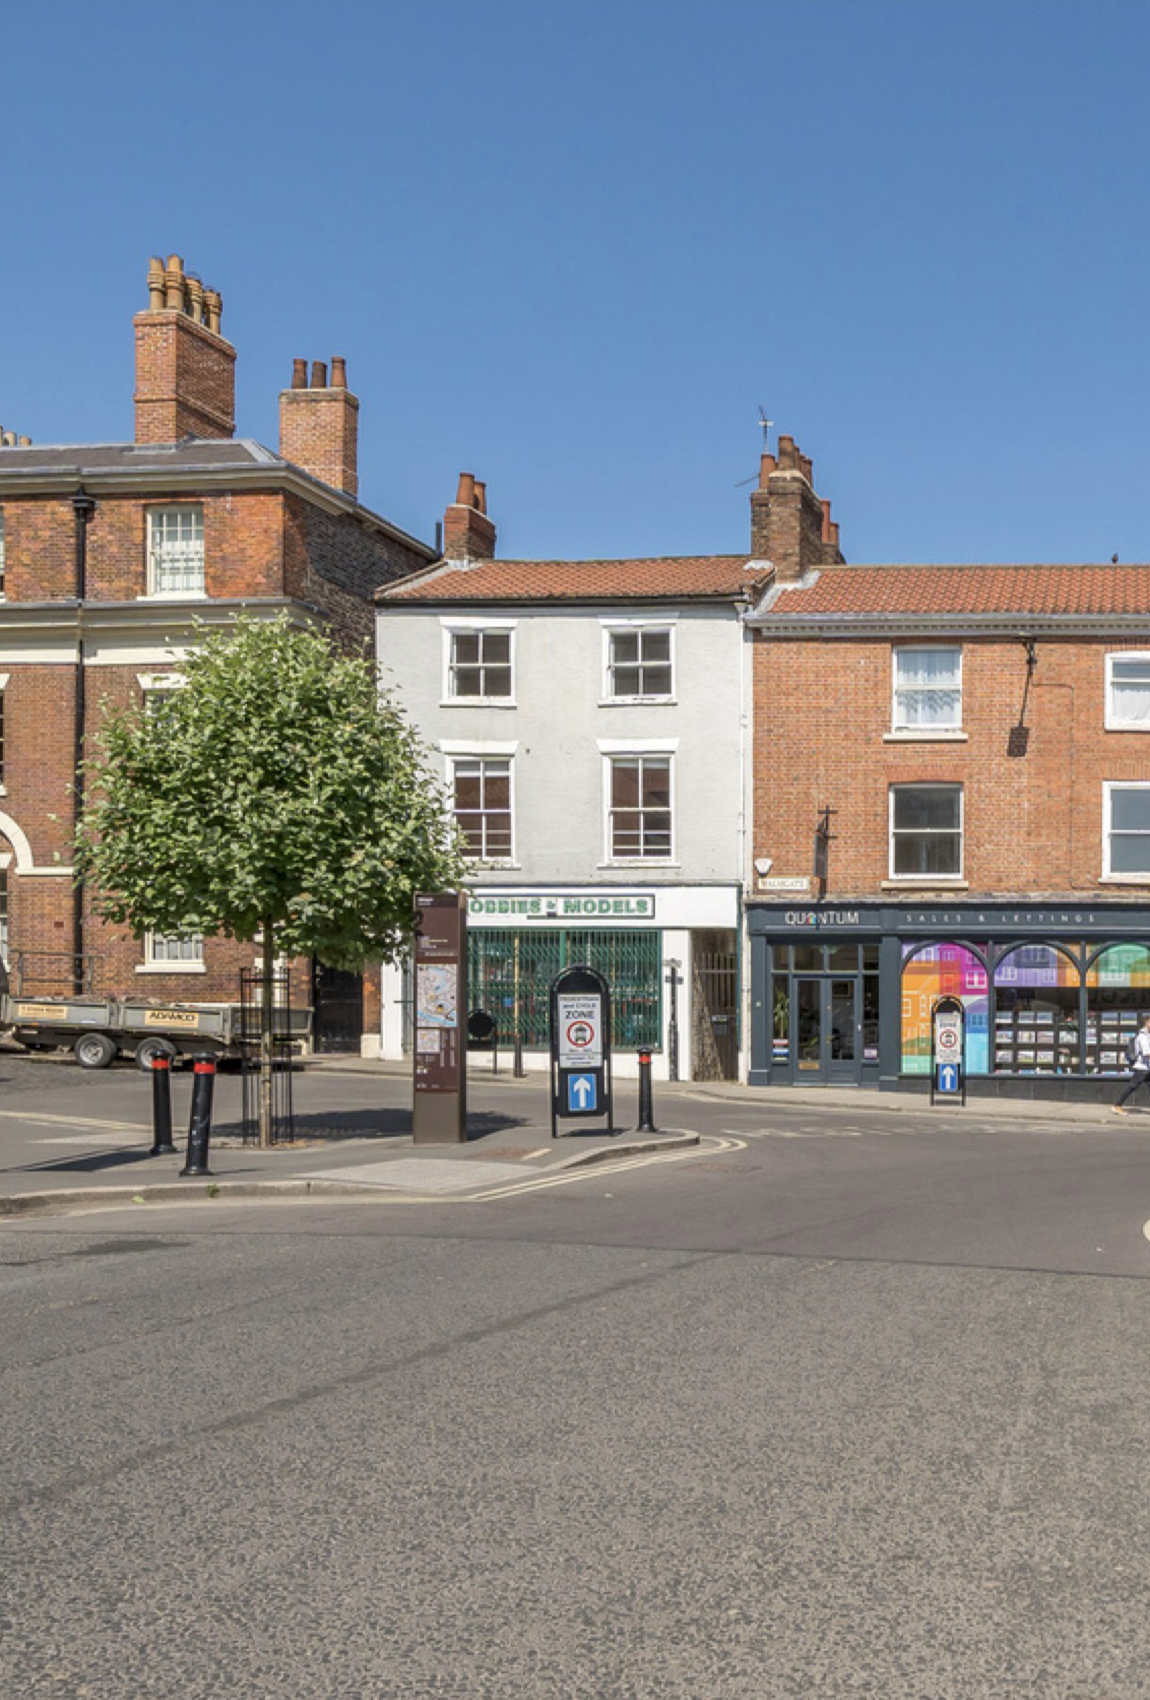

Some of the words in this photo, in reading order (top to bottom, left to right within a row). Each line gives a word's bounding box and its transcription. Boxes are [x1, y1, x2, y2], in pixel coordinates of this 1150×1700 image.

[563, 899, 648, 914] MODELS
[905, 914, 961, 922] SALES
[1001, 914, 1095, 922] LETTINGS
[565, 1010, 595, 1019] ZONE
